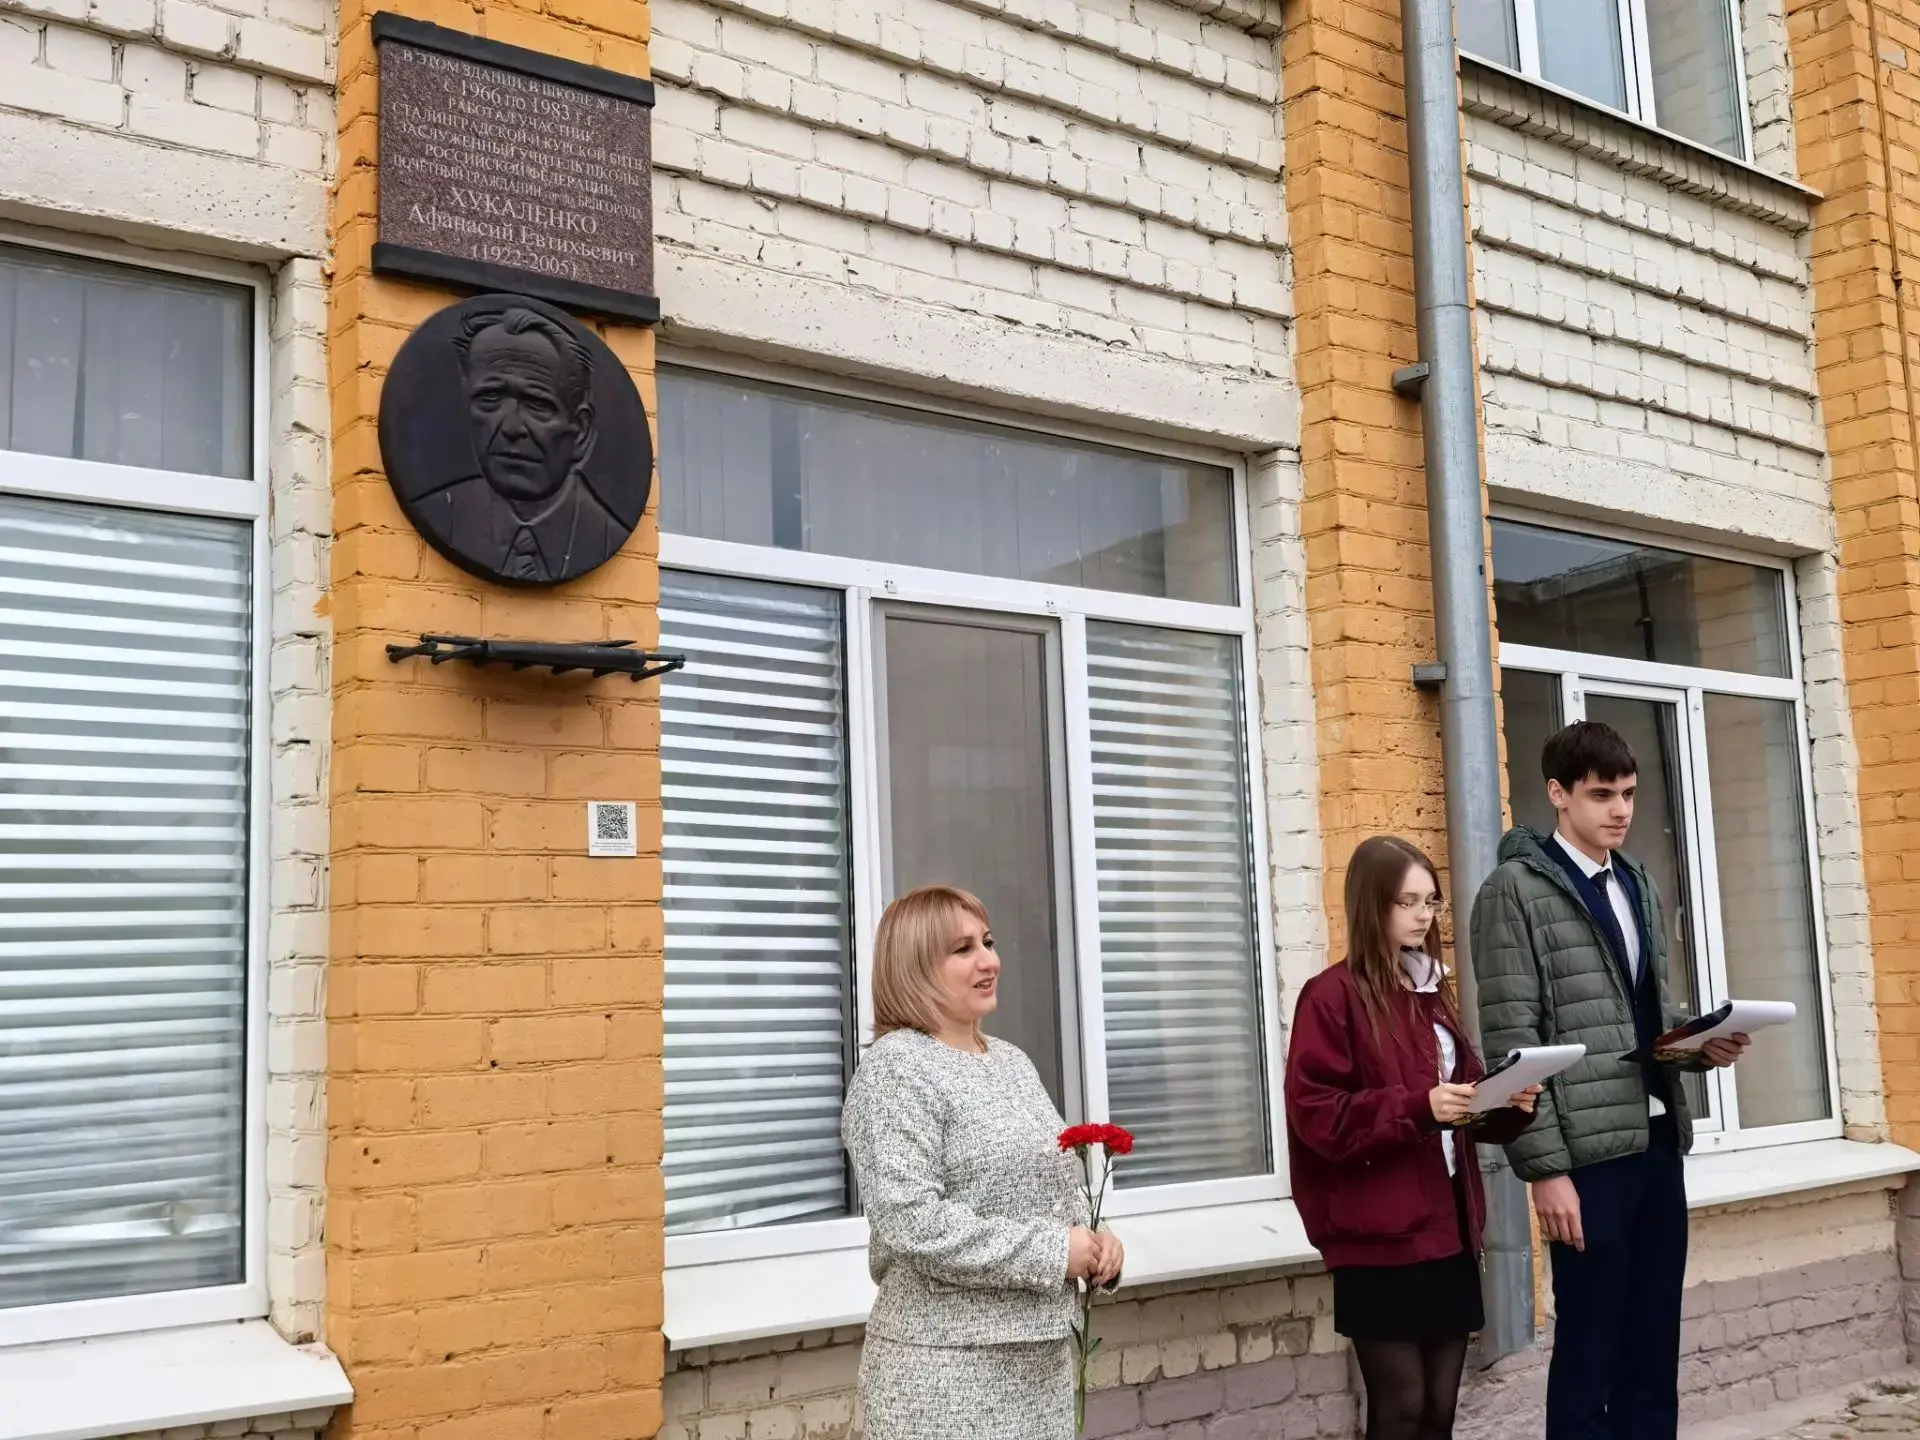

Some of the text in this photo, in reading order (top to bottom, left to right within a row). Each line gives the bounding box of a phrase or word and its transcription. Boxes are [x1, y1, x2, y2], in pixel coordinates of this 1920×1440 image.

[403, 49, 413, 62] В
[416, 53, 460, 74] ЭТОМ
[529, 80, 538, 93] В
[542, 83, 593, 107] ШКОЛЕ
[596, 97, 609, 110] №
[461, 80, 501, 104] 1966
[534, 98, 570, 120] 1983
[392, 102, 526, 142] СТАЛИНГРАДСКОЙ
[544, 138, 606, 160] КУРСКОЙ
[448, 98, 594, 141] РАБОТАЛ УЧАСТНИК
[400, 120, 639, 186] ЗАСЛУЖЕННЫЙ УЧИТЕЛЬ ШКОЛЫ
[425, 143, 524, 176] РОССИЙСКОЙ
[450, 187, 597, 234] ХУКАЛЕНКО
[466, 168, 540, 197] ГРАЖДАНИН
[579, 195, 643, 219] БЕЛГОРОДА
[408, 202, 634, 267] Афанасий Евтихьевич
[472, 244, 577, 278] (1922-2005)
